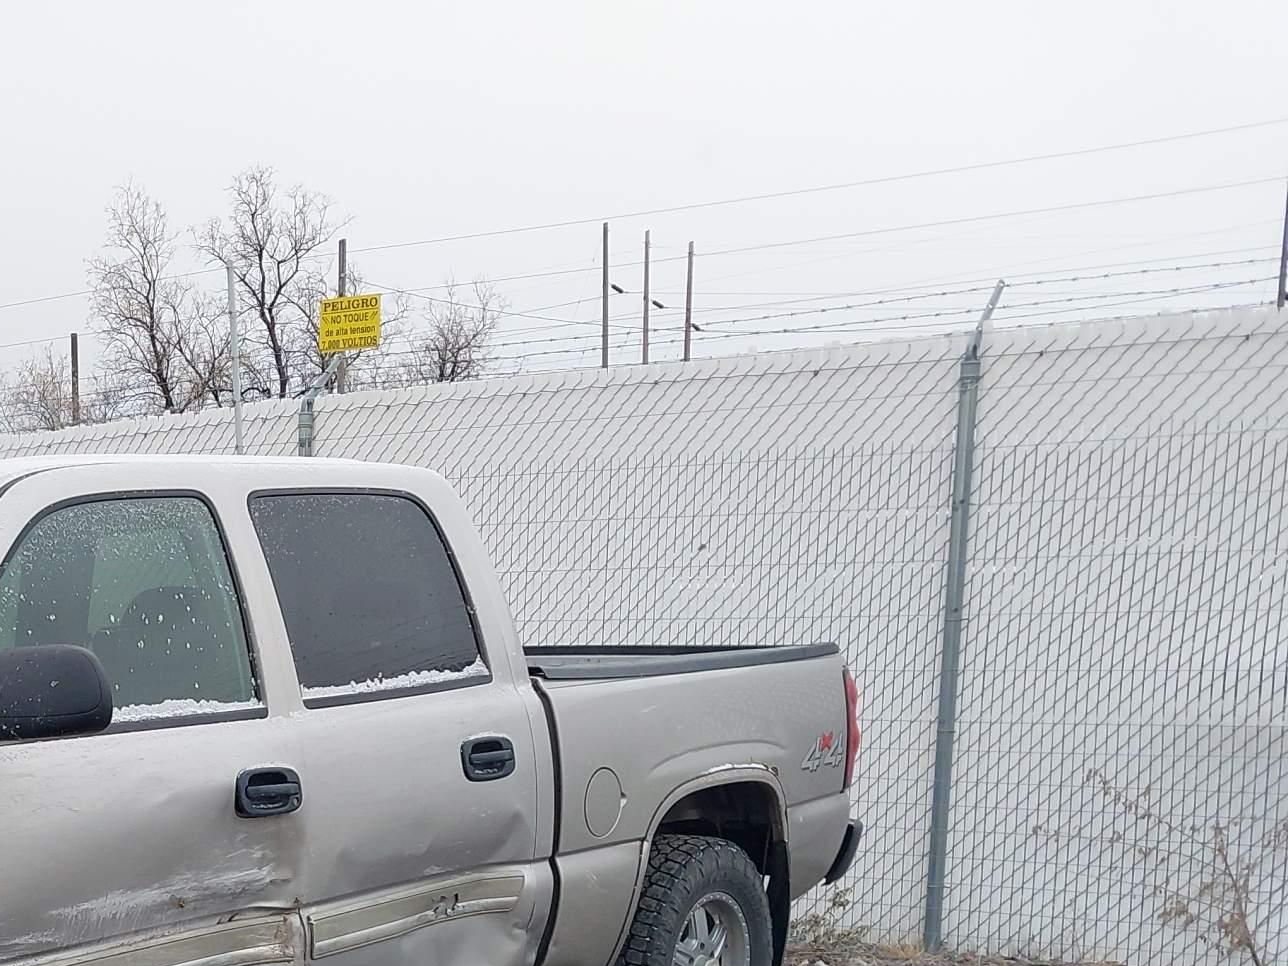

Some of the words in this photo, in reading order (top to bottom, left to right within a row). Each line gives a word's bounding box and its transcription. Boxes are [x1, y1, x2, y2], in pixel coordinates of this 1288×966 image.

[323, 297, 378, 312] PELIGRO
[330, 315, 342, 325] NO
[343, 312, 369, 324] TOQUE
[325, 328, 334, 337] de
[335, 327, 349, 337] alta
[342, 336, 378, 348] VOLTIOS
